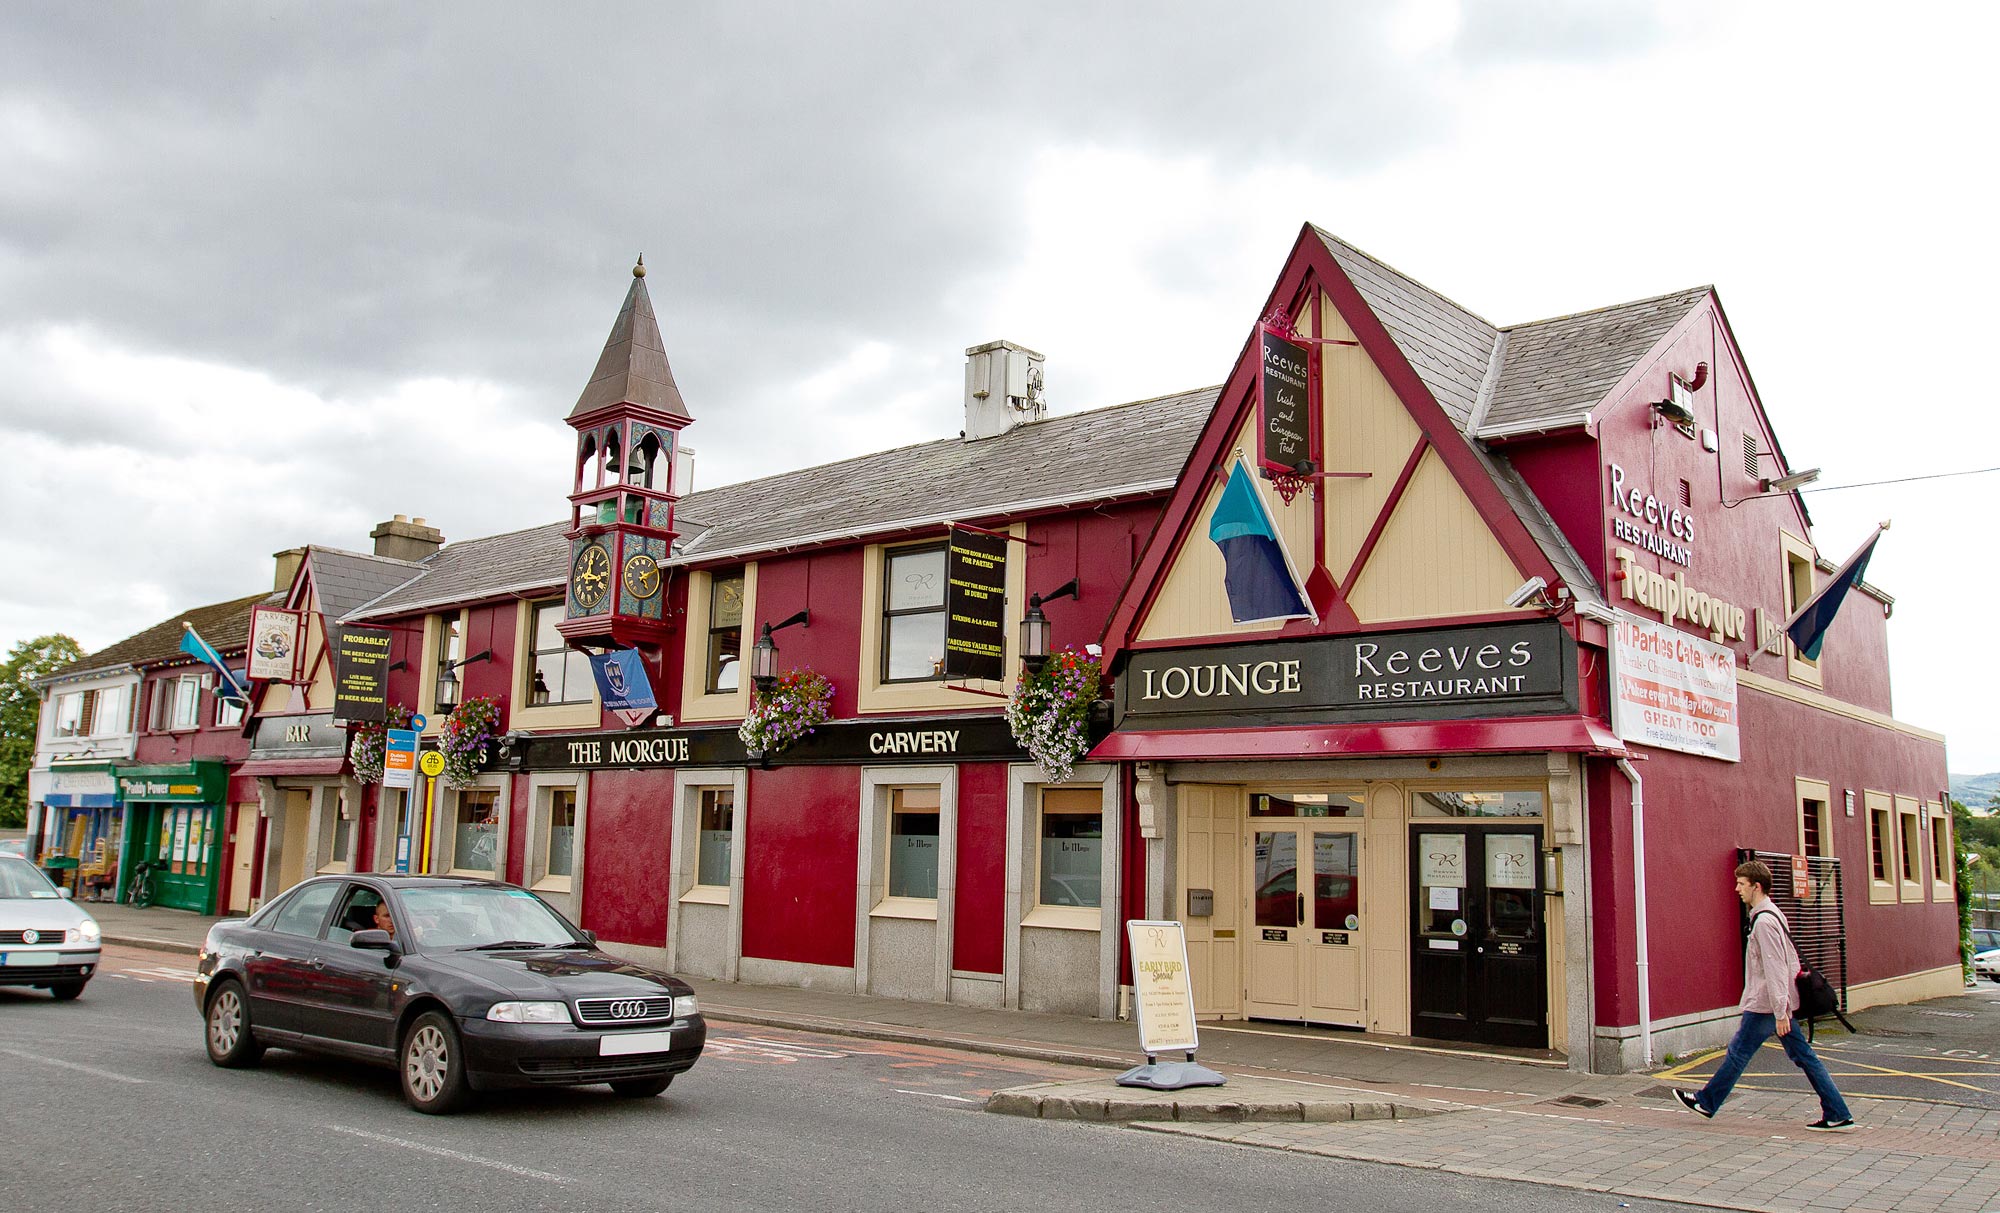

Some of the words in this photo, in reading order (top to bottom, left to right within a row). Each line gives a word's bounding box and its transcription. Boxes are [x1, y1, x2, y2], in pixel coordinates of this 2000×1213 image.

[1264, 345, 1307, 378] Reeves
[1265, 366, 1306, 389] RESTAURANT
[1279, 411, 1294, 423] and
[1270, 417, 1304, 442] European
[1279, 437, 1295, 454] Food
[1611, 464, 1694, 542] Reeves
[1614, 517, 1692, 568] RESTAURANT
[973, 558, 994, 569] PARTIES
[1616, 546, 1746, 645] Templeogue
[257, 613, 295, 625] CARVERY
[343, 634, 390, 647] PROBABLEY
[1355, 641, 1532, 678] Reeves
[1141, 660, 1301, 700] LOUNGE
[1358, 675, 1526, 699] RESTAURANT
[1669, 691, 1698, 715] Tuesday
[286, 725, 310, 742] BAR
[1643, 710, 1682, 730] GREAT
[1686, 721, 1716, 737] FOOD
[568, 741, 601, 764] THE
[609, 738, 690, 764] MORGUE
[869, 730, 960, 754] CARVERY
[126, 780, 147, 797] Paddy
[147, 780, 169, 795] Power
[1140, 961, 1162, 974] EARLY
[1164, 961, 1182, 974] BIRD
[1153, 969, 1174, 984] Special
